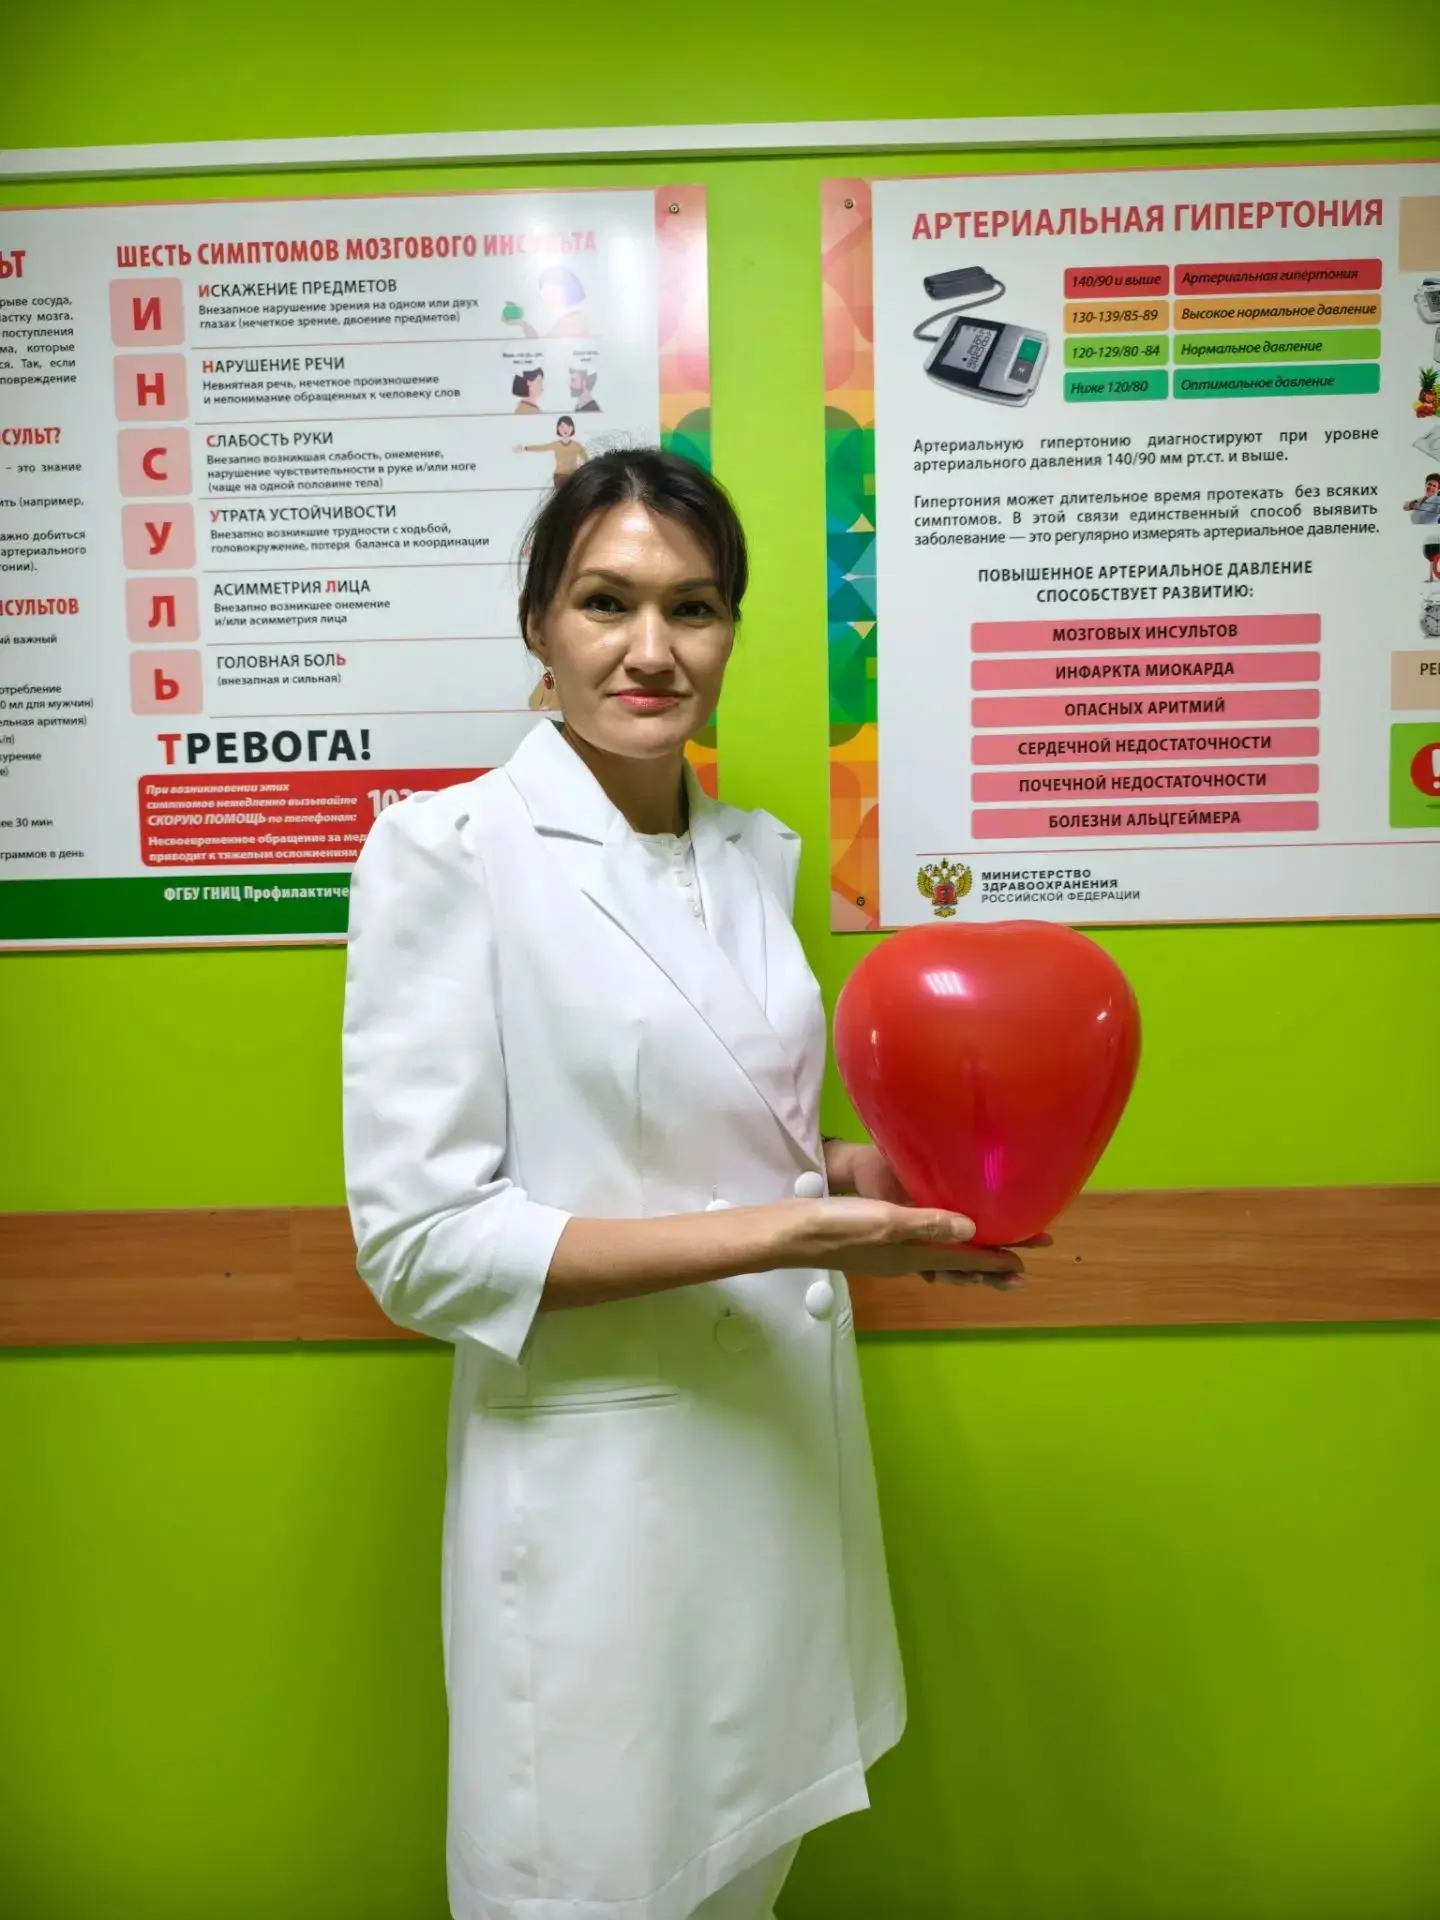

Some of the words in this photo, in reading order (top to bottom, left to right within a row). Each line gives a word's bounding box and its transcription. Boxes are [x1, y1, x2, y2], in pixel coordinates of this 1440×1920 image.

[911, 204, 1164, 240] АРТЕРИАЛЬНАЯ
[1174, 198, 1383, 231] ГИПЕРТОНИЯ
[116, 243, 192, 268] ШЕСТЬ
[197, 238, 339, 265] СИМПТОМОВ
[345, 234, 476, 260] МОЗГОВОГО
[1072, 274, 1113, 287] 140/90
[1124, 275, 1161, 286] выше
[1181, 271, 1279, 286] Артериальная
[1279, 269, 1359, 283] гипертония
[198, 281, 297, 297] ИСКАЖЕНИЕ
[301, 278, 397, 296] ПРЕДМЕТОВ
[132, 297, 162, 331] И
[198, 304, 260, 315] Внезапное
[262, 303, 326, 315] нарушение
[329, 301, 370, 313] зрения
[372, 301, 386, 310] на
[388, 300, 426, 310] одном
[428, 299, 450, 308] или
[451, 298, 478, 309] двух
[1181, 307, 1235, 320] Высокое
[1236, 306, 1315, 320] нормальное
[1316, 303, 1377, 315] давление
[199, 320, 236, 329] глазах
[238, 317, 295, 328] (нечеткое
[297, 317, 340, 328] зрение,
[342, 315, 391, 326] двоение
[393, 311, 460, 325] предметов)
[1072, 308, 1158, 323] 130-139/85-89
[1, 327, 74, 339] поступления
[26, 343, 75, 354] которые
[1180, 343, 1261, 357] Нормальное
[1262, 340, 1323, 352] давление
[202, 357, 300, 373] НАРУШЕНИЕ
[304, 356, 344, 370] РЕЧИ
[136, 372, 166, 406] Н
[1070, 382, 1105, 394] Ниже
[1108, 379, 1149, 393] 120/80
[1180, 378, 1273, 391] Оптимальное
[1274, 375, 1335, 388] давление
[213, 394, 291, 404] непонимание
[293, 390, 367, 403] обращенных
[378, 390, 432, 399] человеку
[433, 388, 460, 397] слов
[205, 432, 289, 447] СЛАБОСТЬ
[293, 431, 333, 445] РУКИ
[913, 438, 1024, 455] Артериальную
[1040, 436, 1131, 451] гипертонию
[1146, 432, 1263, 448] диагностируют
[1279, 431, 1307, 445] при
[1324, 428, 1379, 444] уровне
[40, 463, 82, 472] знание
[141, 447, 168, 481] С
[913, 457, 1027, 474] артериального
[1029, 455, 1102, 470] давления
[1106, 451, 1156, 465] 140/90
[1159, 453, 1182, 464] мм
[1186, 452, 1224, 467] рт.ст.
[1241, 450, 1288, 462] выше.
[207, 468, 271, 480] нарушение
[273, 465, 375, 478] чувствительности
[386, 464, 413, 475] руке
[415, 462, 448, 472] и/или
[450, 462, 476, 471] ноге
[914, 494, 1000, 511] Гипертония
[1006, 494, 1054, 506] может
[1059, 491, 1148, 506] длительное
[1153, 490, 1201, 505] время
[1206, 488, 1284, 503] протекать
[1294, 483, 1320, 498] без
[1326, 485, 1378, 497] всяких
[209, 508, 266, 522] УТРАТА
[269, 504, 396, 521] УСТОЙЧИВОСТИ
[913, 514, 1001, 527] симптомов.
[1032, 509, 1065, 524] этой
[1076, 511, 1119, 523] связи
[1129, 504, 1239, 523] единственный
[1249, 502, 1302, 518] способ
[1312, 504, 1378, 516] выявить
[32, 529, 86, 542] добиться
[144, 521, 173, 555] У
[914, 531, 1006, 545] заболевание
[1028, 531, 1052, 543] это
[1054, 529, 1129, 545] регулярно
[1132, 527, 1200, 542] измерять
[1202, 524, 1304, 541] артериальное
[1306, 522, 1379, 537] давление.
[0, 546, 86, 559] артериального
[210, 542, 308, 554] головокружение,
[310, 541, 350, 551] потеря
[354, 537, 400, 549] баланса
[412, 537, 489, 549] координации
[978, 565, 1093, 582] ПОВЫШЕННОЕ
[1097, 562, 1222, 579] АРТЕРИАЛЬНОЕ
[1226, 559, 1312, 578] ДАВЛЕНИЕ
[213, 580, 321, 596] АСИММЕТРИЯ
[325, 579, 370, 595] ЛИЦА
[1036, 586, 1158, 603] СПОСОБСТВУЕТ
[1162, 583, 1253, 599] РАЗВИТИЮ:
[148, 595, 176, 628] Л
[214, 616, 247, 626] и/или
[249, 615, 318, 626] асимметрия
[319, 614, 347, 624] лица
[12, 634, 57, 644] важный
[1052, 626, 1141, 641] МОЗГОВЫХ
[1145, 623, 1238, 639] ИНСУЛЬТОВ
[216, 653, 299, 669] ГОЛОВНАЯ
[303, 652, 346, 667] БОЛЬ
[1419, 662, 1440, 676] РЕ
[1055, 663, 1140, 679] ИНФАРКТА
[1145, 661, 1234, 678] МИОКАРДА
[153, 668, 180, 701] Ь
[47, 698, 93, 710] мужчин)
[1064, 701, 1143, 716] ОПАСНЫХ
[1147, 696, 1225, 714] АРИТМИЙ
[36, 716, 87, 727] аритмия)
[156, 729, 372, 765] ТРЕВОГА!
[1017, 737, 1110, 757] СЕРДЕЧНОЙ
[1115, 735, 1271, 754] НЕДОСТАТОЧНОСТИ
[169, 784, 258, 794] возникновении
[258, 783, 289, 792] этих
[1019, 774, 1106, 792] ПОЧЕЧНОЙ
[1111, 772, 1266, 792] НЕДОСТАТОЧНОСТИ
[145, 799, 215, 809] симптомов
[215, 796, 287, 808] немедленно
[286, 795, 357, 806] вызывайте
[15, 817, 29, 827] 30
[147, 813, 203, 826] СКОРУЮ
[203, 812, 267, 826] ПОМОЩЬ
[283, 811, 357, 824] телефонам:
[1048, 813, 1121, 828] БОЛЕЗНИ
[1125, 809, 1240, 828] АЛЬЦГЕЙМЕРА
[147, 835, 256, 847] Несвоевременное
[256, 832, 326, 845] обращение
[57, 850, 84, 859] день
[148, 852, 207, 863] приводит
[216, 850, 274, 859] тяжелым
[981, 868, 1091, 880] МИНИСТЕРСТВО
[163, 886, 200, 901] ФГБУ
[202, 885, 241, 902] ГНИЦ
[982, 878, 1117, 893] ЗДРАВООХРАНЕНИЯ
[981, 890, 1063, 903] РОССИЙСКОЙ
[1066, 890, 1140, 901] ФЕДЕРАЦИИ
